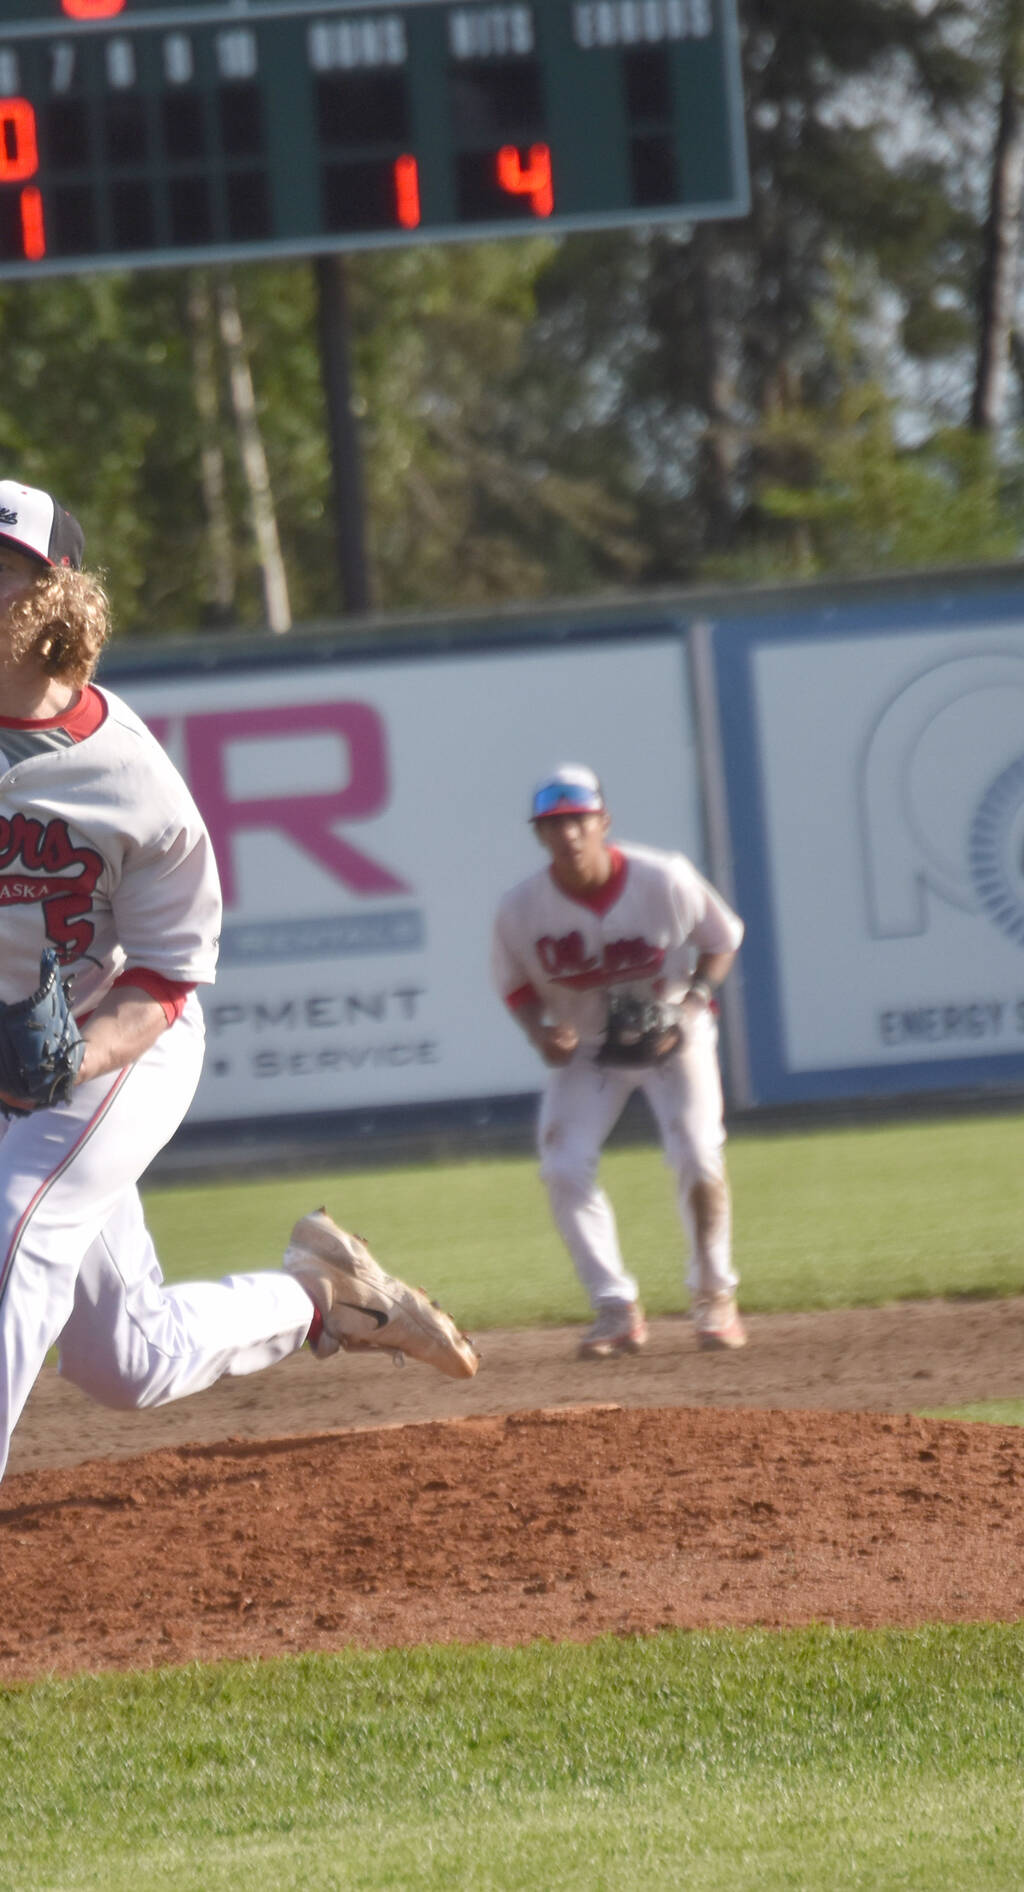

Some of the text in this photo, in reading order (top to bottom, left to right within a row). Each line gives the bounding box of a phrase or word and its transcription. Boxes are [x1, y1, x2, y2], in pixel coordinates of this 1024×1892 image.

[394, 154, 420, 229] 1
[496, 143, 554, 217] 4
[41, 893, 96, 967] 5
[209, 981, 429, 1038] PMENT
[879, 1000, 1006, 1047] ENERGY
[251, 1039, 440, 1079] SERVICE
